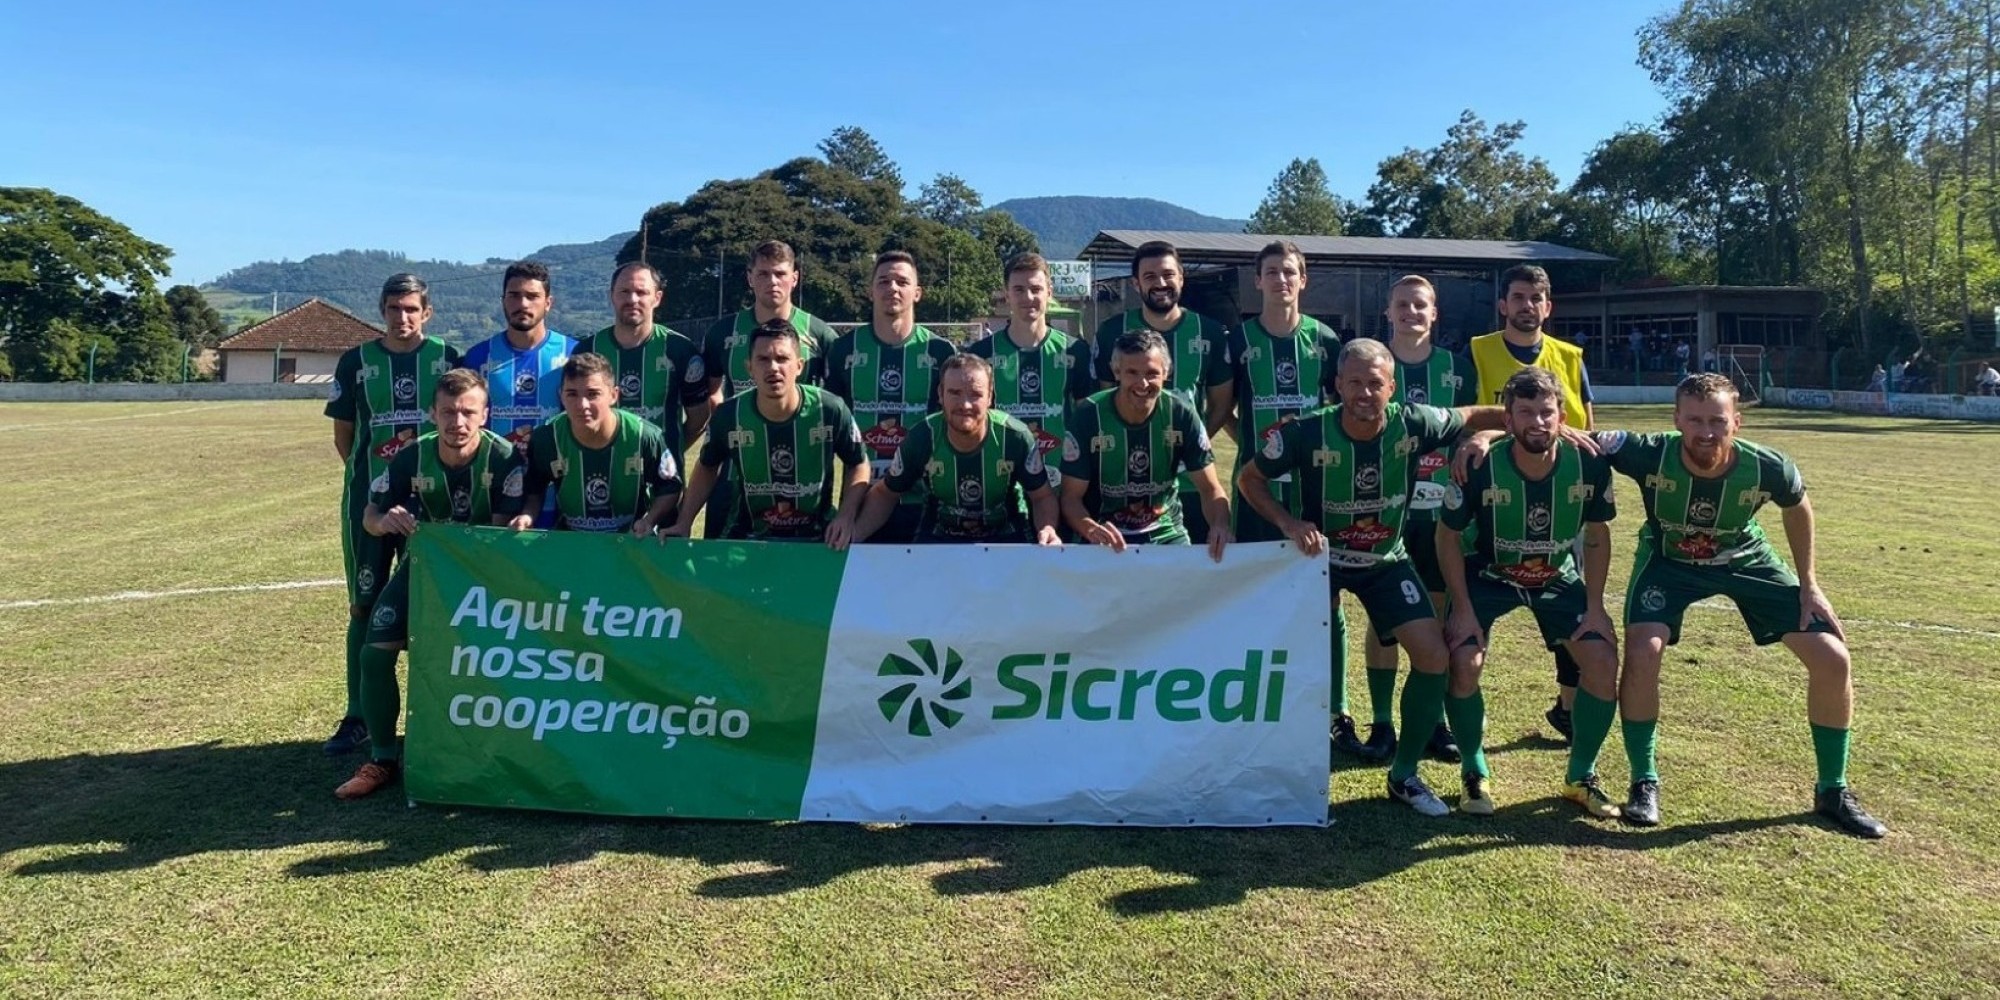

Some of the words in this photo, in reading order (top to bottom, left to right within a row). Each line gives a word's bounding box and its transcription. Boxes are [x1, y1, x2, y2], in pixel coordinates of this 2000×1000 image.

[450, 585, 571, 640] Aqui
[582, 596, 683, 639] tem
[1400, 580, 1421, 605] 9
[450, 644, 605, 682] nossa
[991, 649, 1288, 723] Sicredi
[448, 693, 750, 749] cooperação
